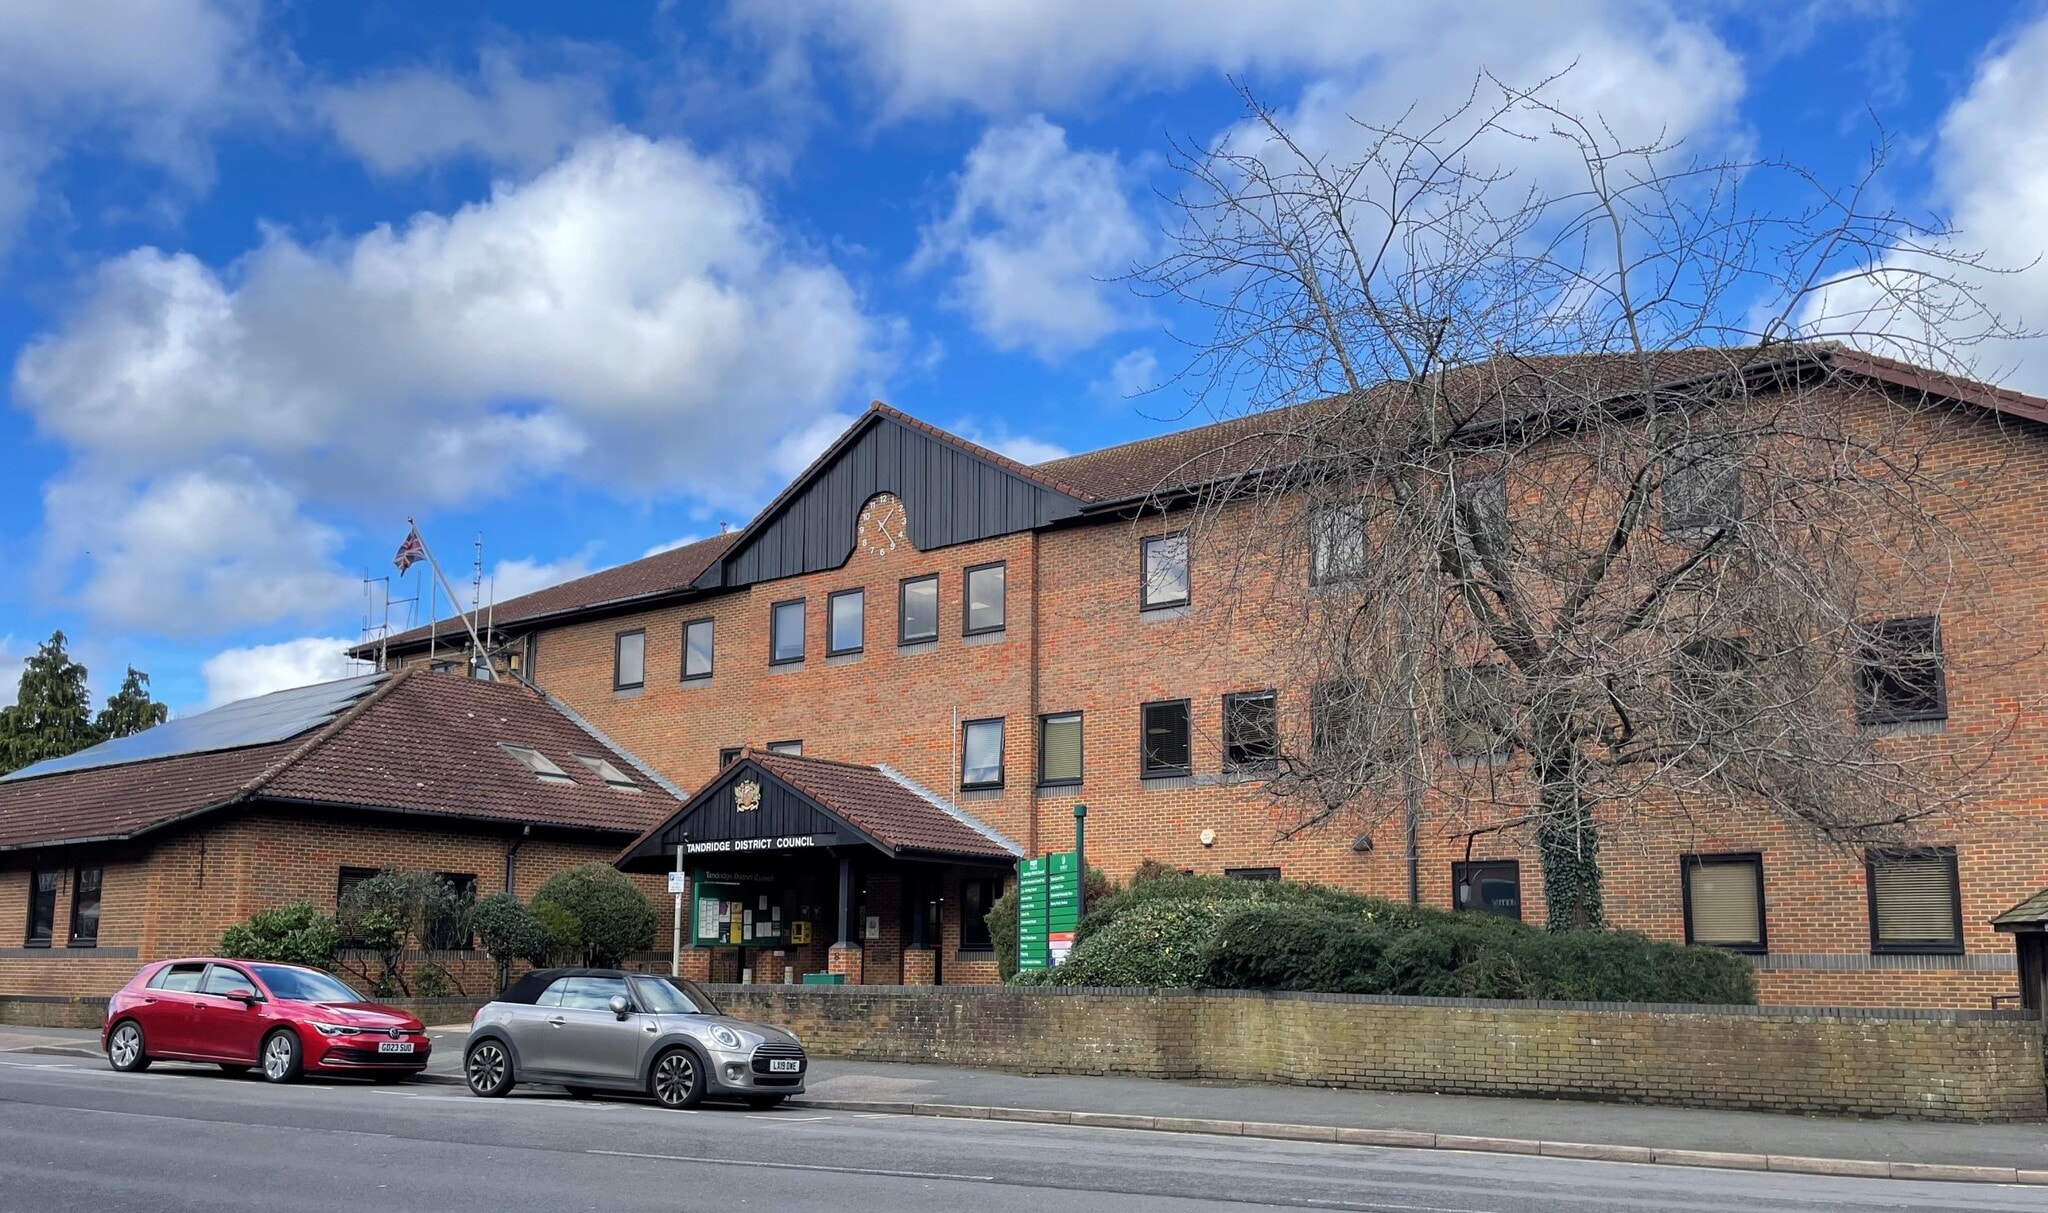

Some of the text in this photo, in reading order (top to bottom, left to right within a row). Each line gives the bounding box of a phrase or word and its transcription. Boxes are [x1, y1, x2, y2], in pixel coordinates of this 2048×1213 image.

[880, 495, 887, 503] 12
[862, 539, 868, 547] 8
[879, 548, 885, 556] 6
[686, 836, 815, 853] TANDRIDGE DISTRICT COUNCIL
[834, 952, 840, 961] 8
